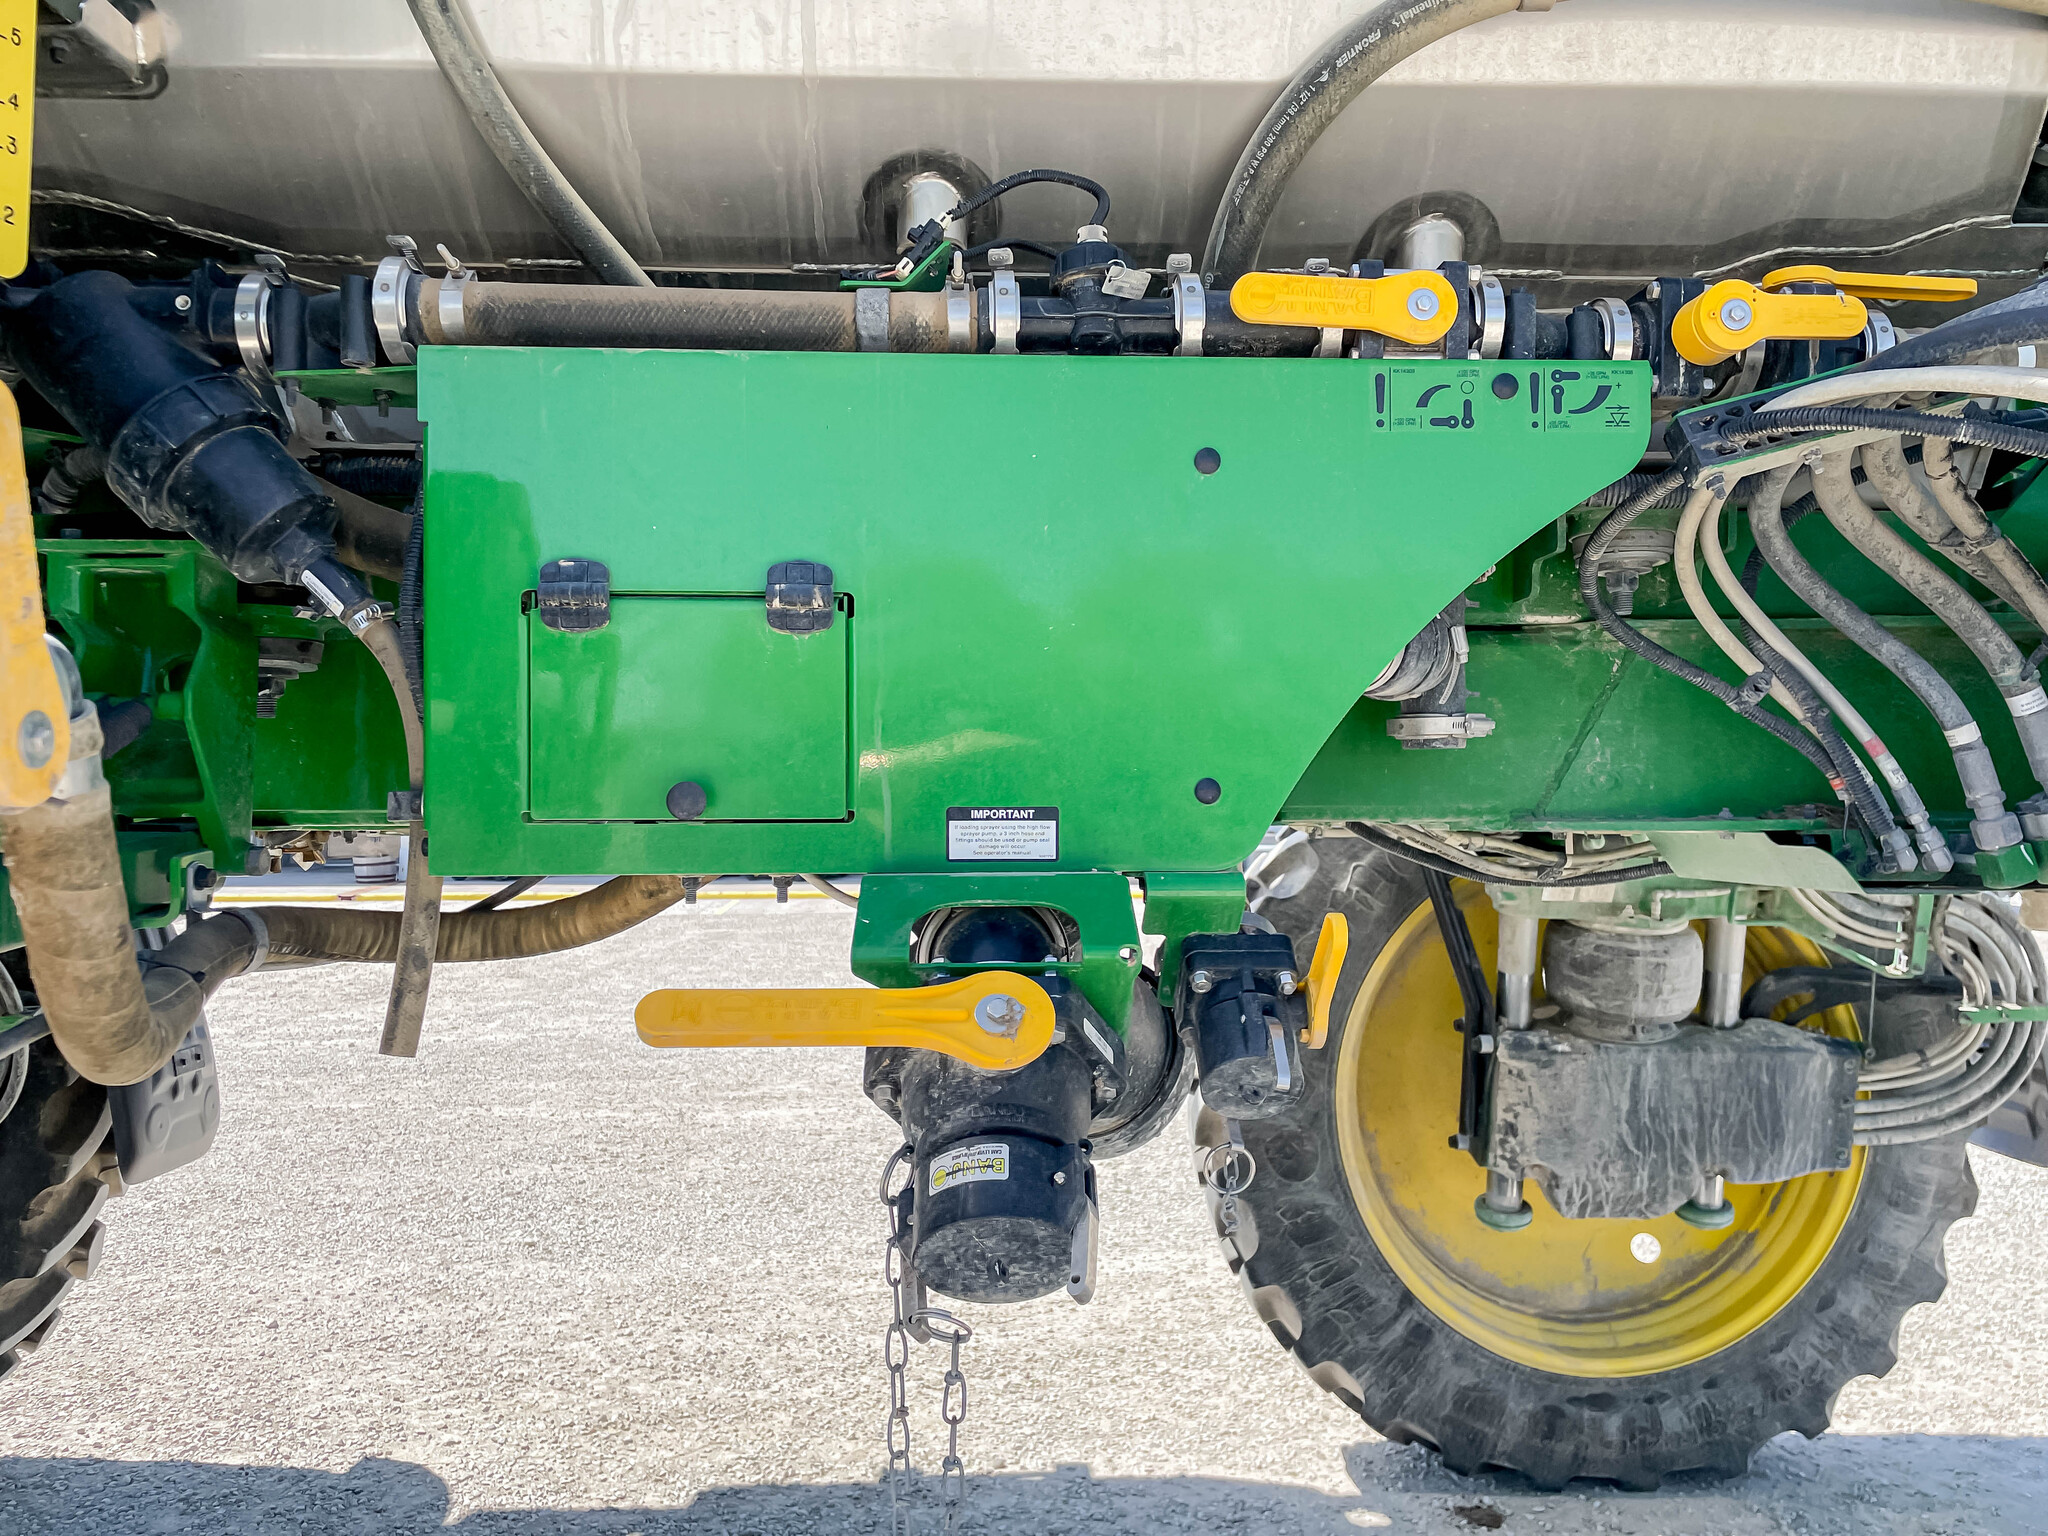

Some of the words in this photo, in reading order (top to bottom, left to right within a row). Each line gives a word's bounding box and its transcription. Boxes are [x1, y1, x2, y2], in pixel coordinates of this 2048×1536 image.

[11, 28, 22, 46] 5
[1335, 28, 1381, 68] FRONTIER
[8, 93, 19, 111] 4
[6, 135, 18, 155] 3
[1264, 132, 1276, 147] 200
[1256, 144, 1267, 162] PSI
[3, 206, 15, 225] 2
[970, 810, 1035, 819] IMPORTANT
